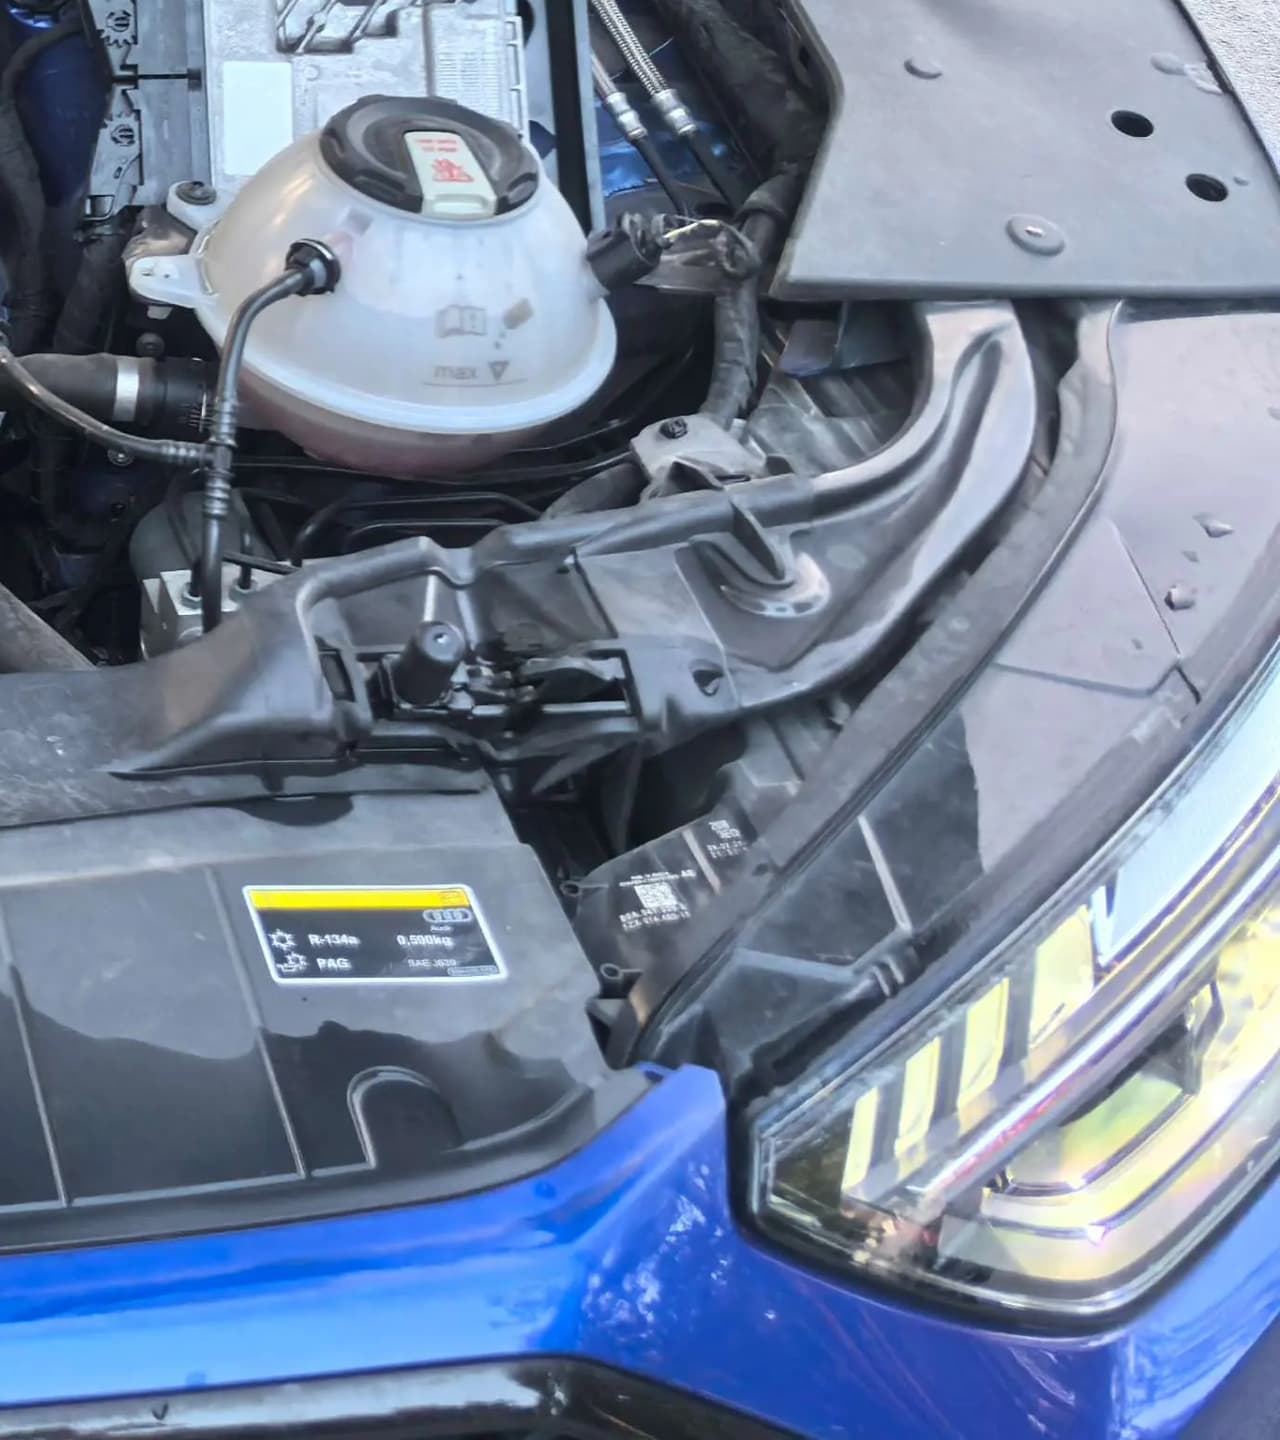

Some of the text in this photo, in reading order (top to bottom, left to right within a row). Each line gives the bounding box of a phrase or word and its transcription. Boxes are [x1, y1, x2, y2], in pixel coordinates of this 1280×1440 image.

[433, 365, 477, 379] max
[307, 933, 361, 945] R-134a
[316, 958, 352, 970] PAG
